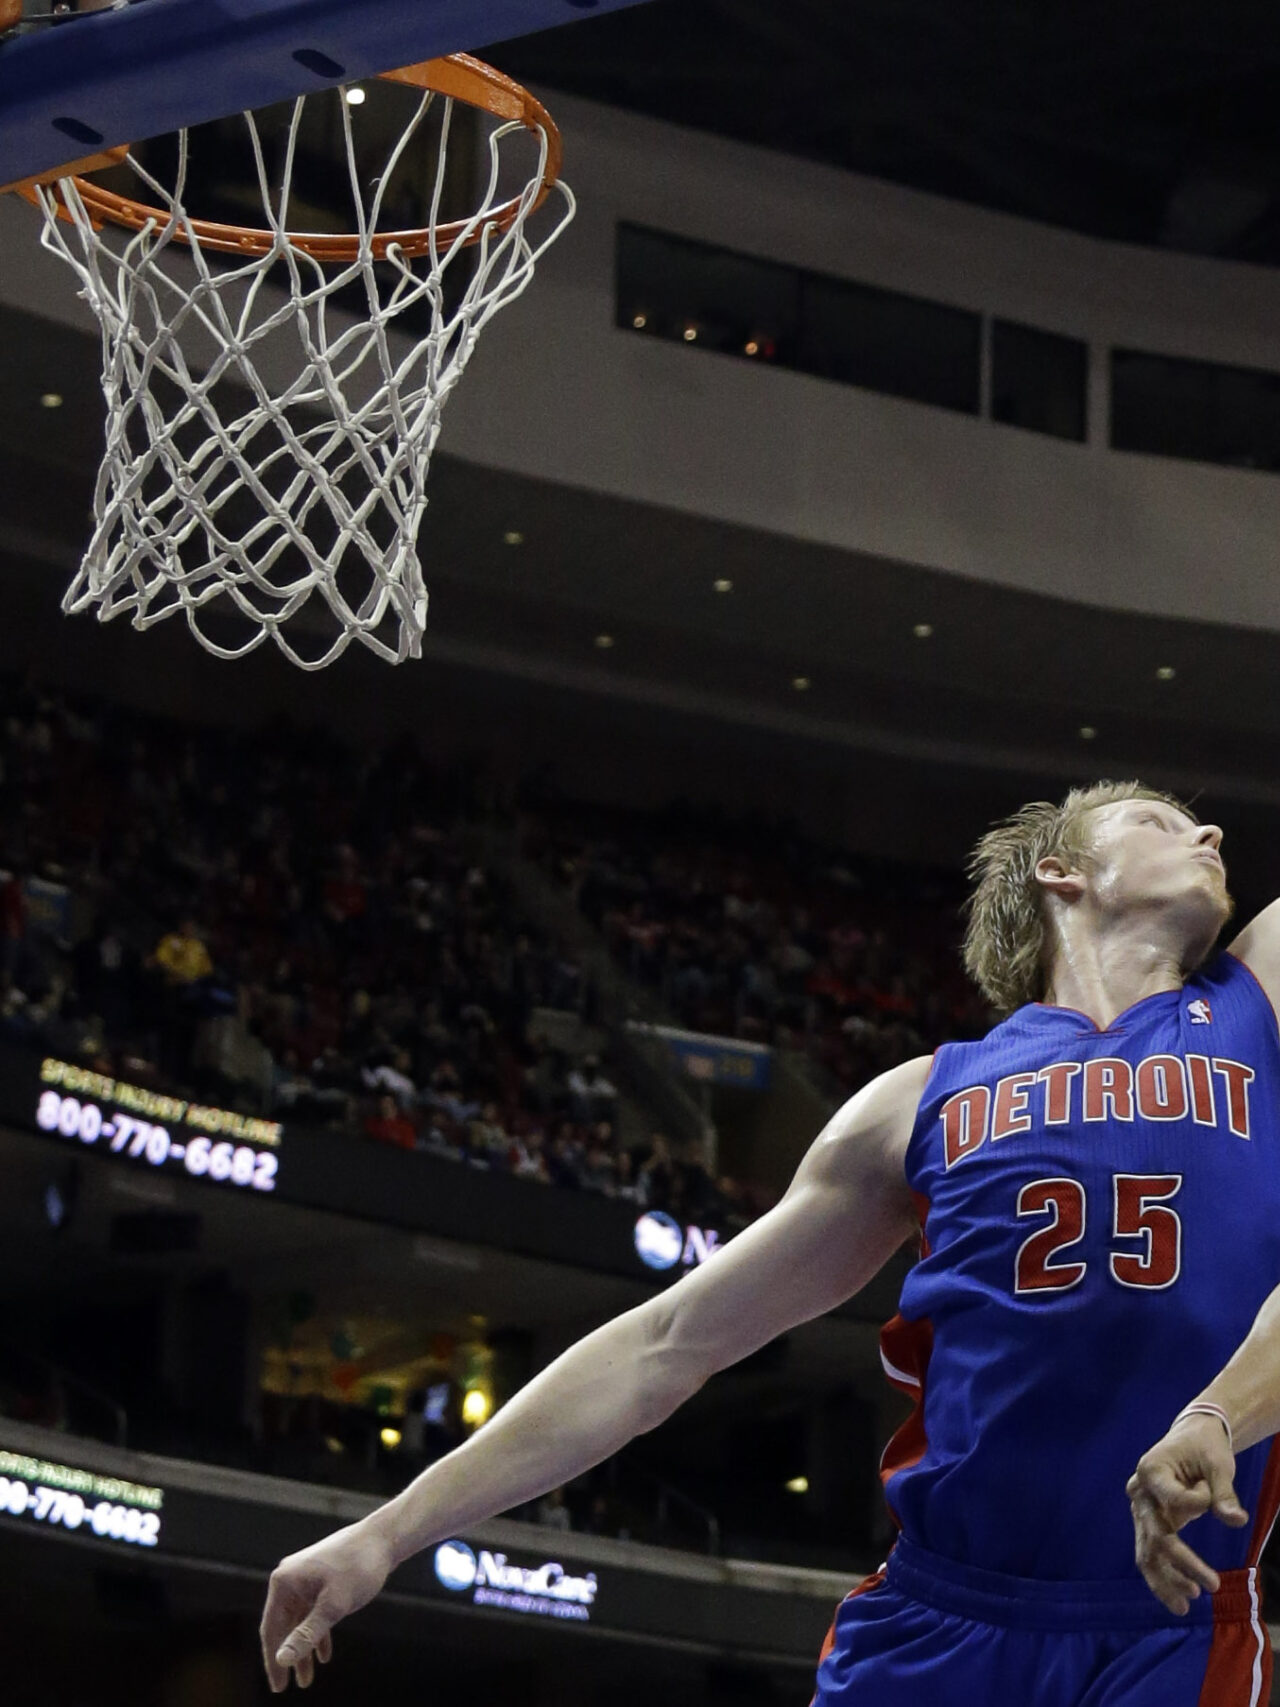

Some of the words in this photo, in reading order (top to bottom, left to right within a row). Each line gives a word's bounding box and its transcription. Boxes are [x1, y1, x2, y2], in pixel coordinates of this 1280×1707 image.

[36, 1090, 279, 1192] 800-770-6682
[939, 1053, 1256, 1171] DETROIT
[1014, 1174, 1183, 1295] 25
[475, 1550, 597, 1605] NovaCare
